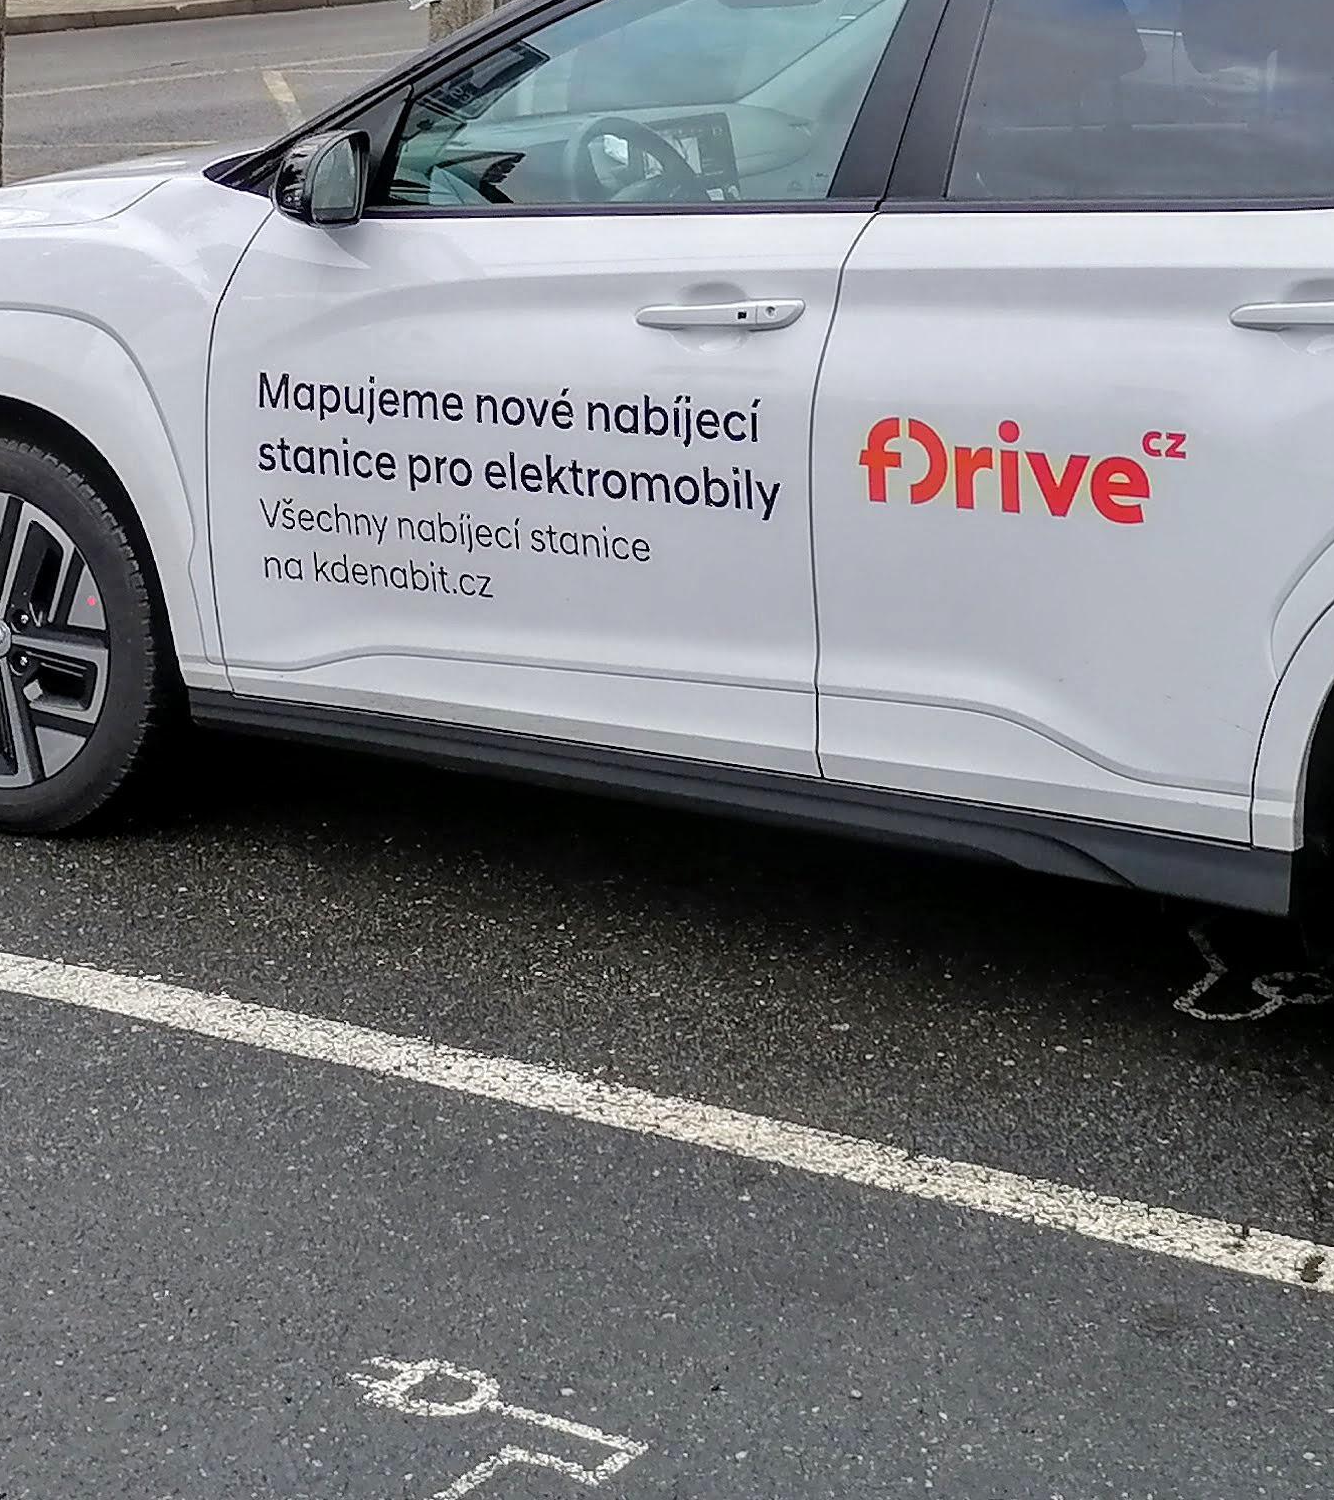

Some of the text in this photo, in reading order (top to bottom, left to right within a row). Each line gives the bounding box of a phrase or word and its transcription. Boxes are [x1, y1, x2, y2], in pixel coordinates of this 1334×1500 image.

[258, 372, 762, 448] Mapujeme nové nabíjecí
[258, 437, 781, 521] stanice pro elektromobily
[858, 416, 1151, 524] fDrive
[259, 498, 651, 563] Všechny nabíjecí stanice
[263, 551, 495, 599] na kdenabit.cz
